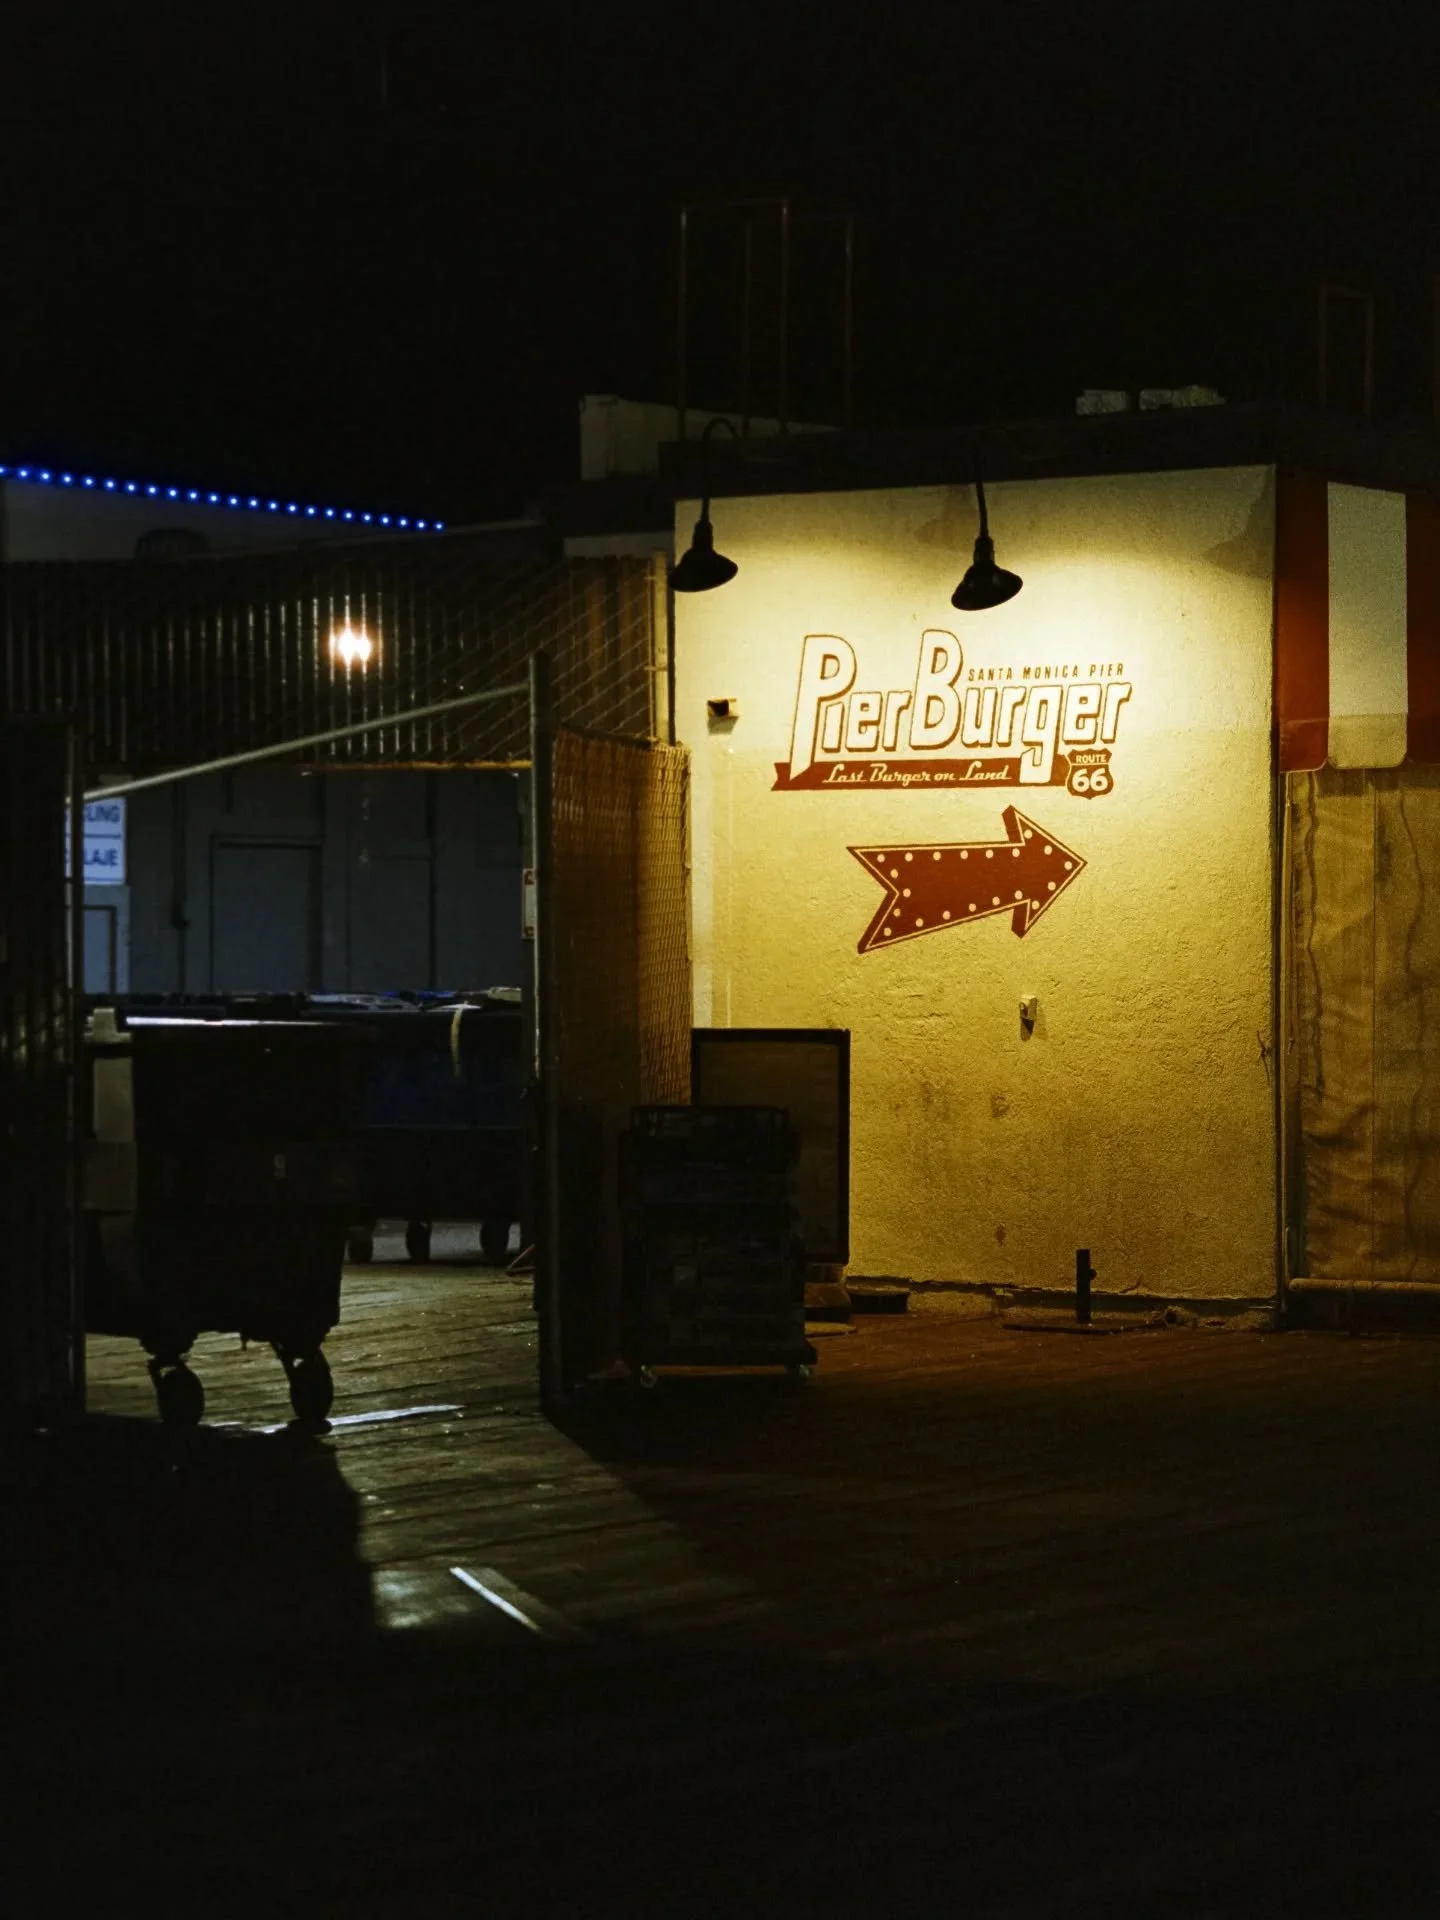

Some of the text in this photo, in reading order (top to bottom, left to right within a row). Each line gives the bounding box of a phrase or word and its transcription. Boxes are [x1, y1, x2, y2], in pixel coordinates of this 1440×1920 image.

[968, 663, 1125, 682] SANTA MONICA PIER
[1075, 753, 1107, 764] ROUTE
[822, 760, 1013, 787] Last Burger on Land
[1072, 767, 1109, 793] 66
